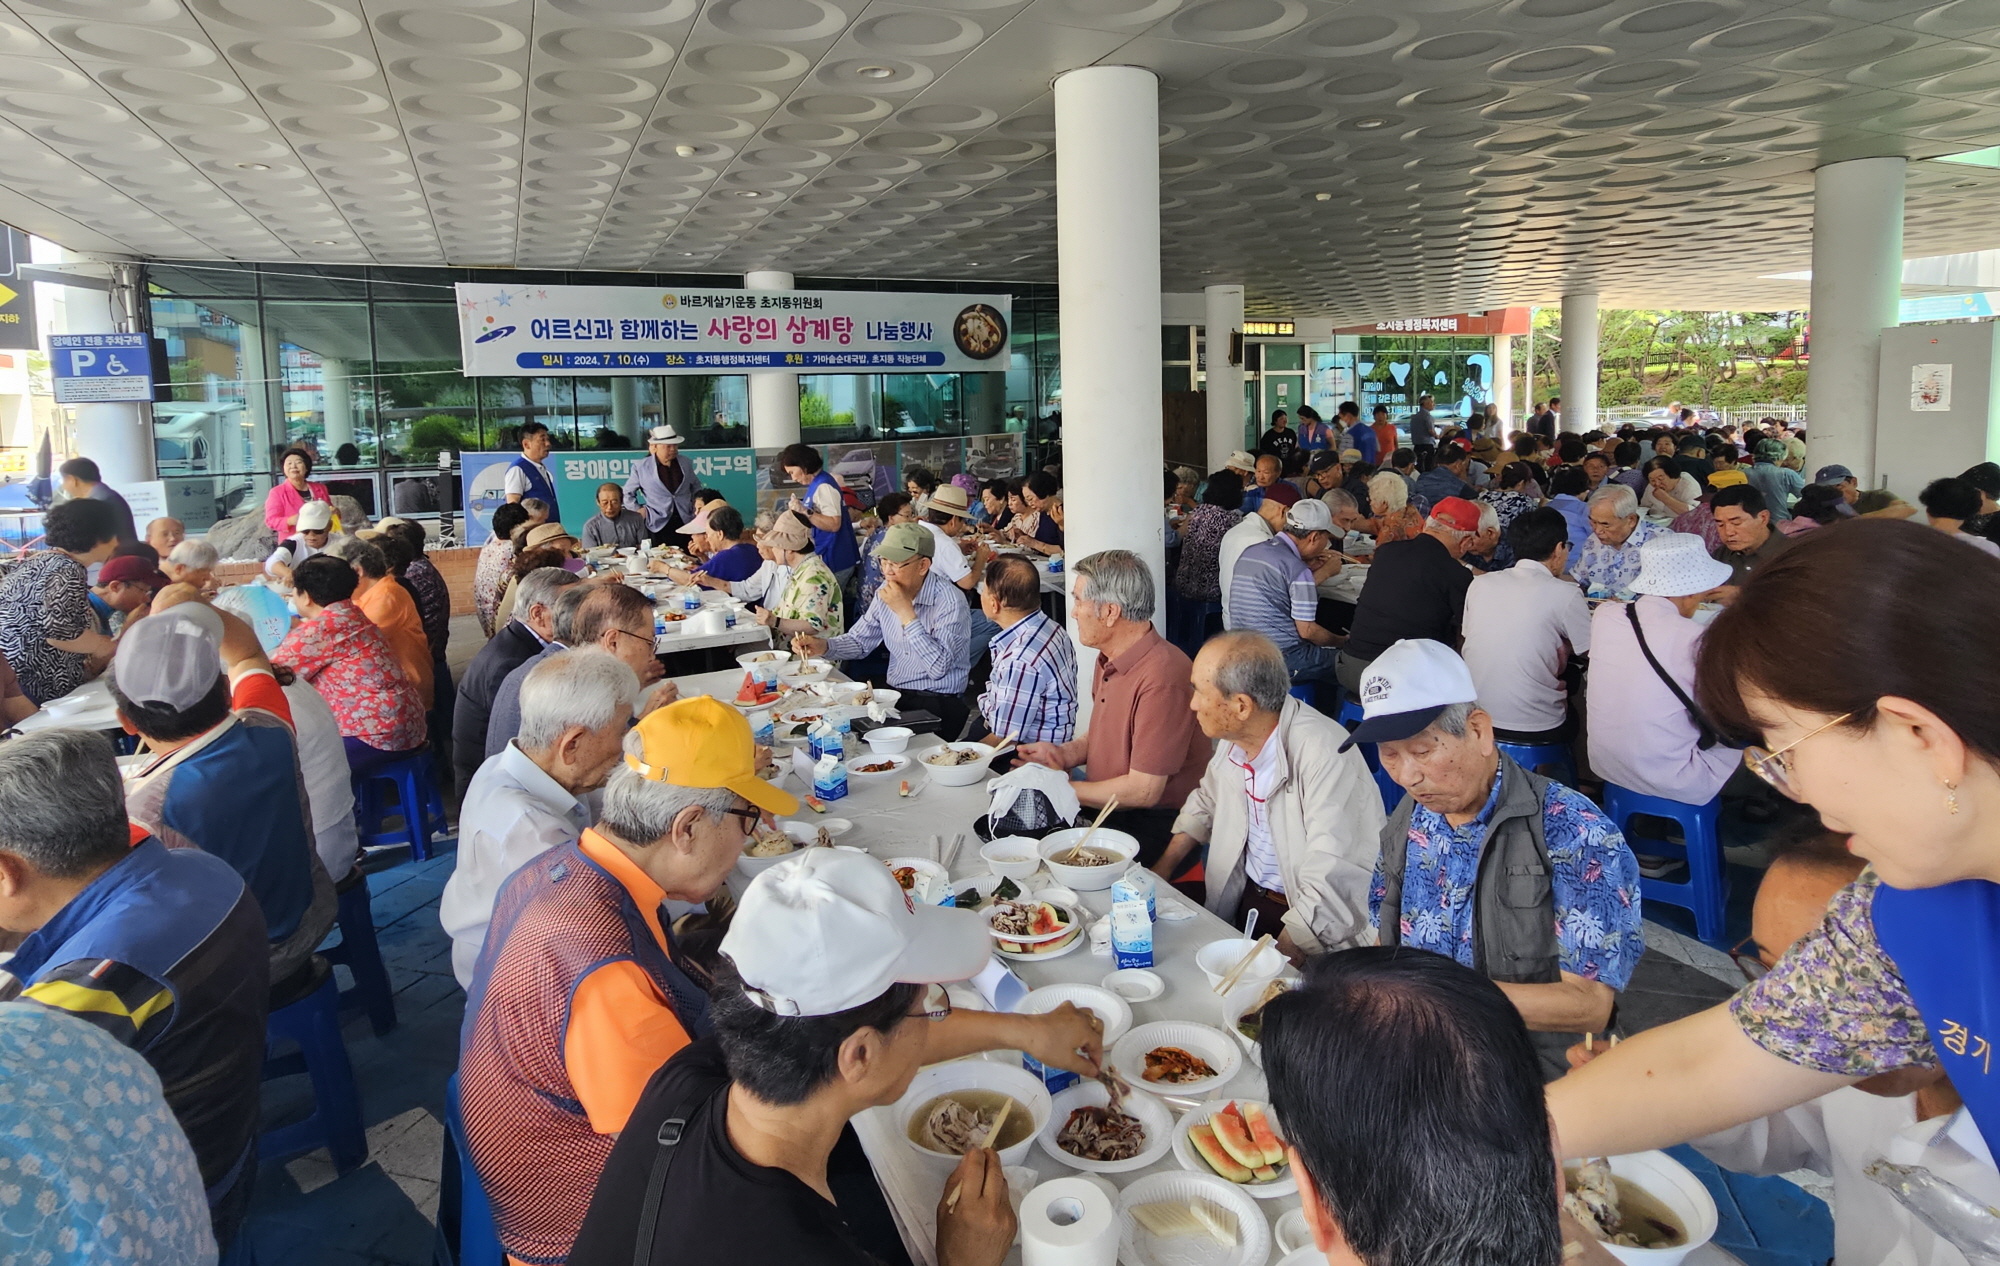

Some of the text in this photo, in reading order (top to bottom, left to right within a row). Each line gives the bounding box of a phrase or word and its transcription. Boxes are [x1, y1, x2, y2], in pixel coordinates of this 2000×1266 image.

[680, 294, 823, 310] 바르게살기운동 초지동위원회
[531, 315, 932, 345] 어르신과 함께하는 사랑의 삼계탕 나눔행사
[52, 335, 142, 347] 장애인 전용 주차구역
[70, 350, 96, 377] P
[541, 355, 563, 366] 일시
[665, 355, 686, 366] 장소
[695, 355, 770, 365] 초지동행정복지센터
[785, 354, 804, 365] 후원
[871, 354, 895, 364] 초지동
[1938, 1018, 1991, 1075] 경기
